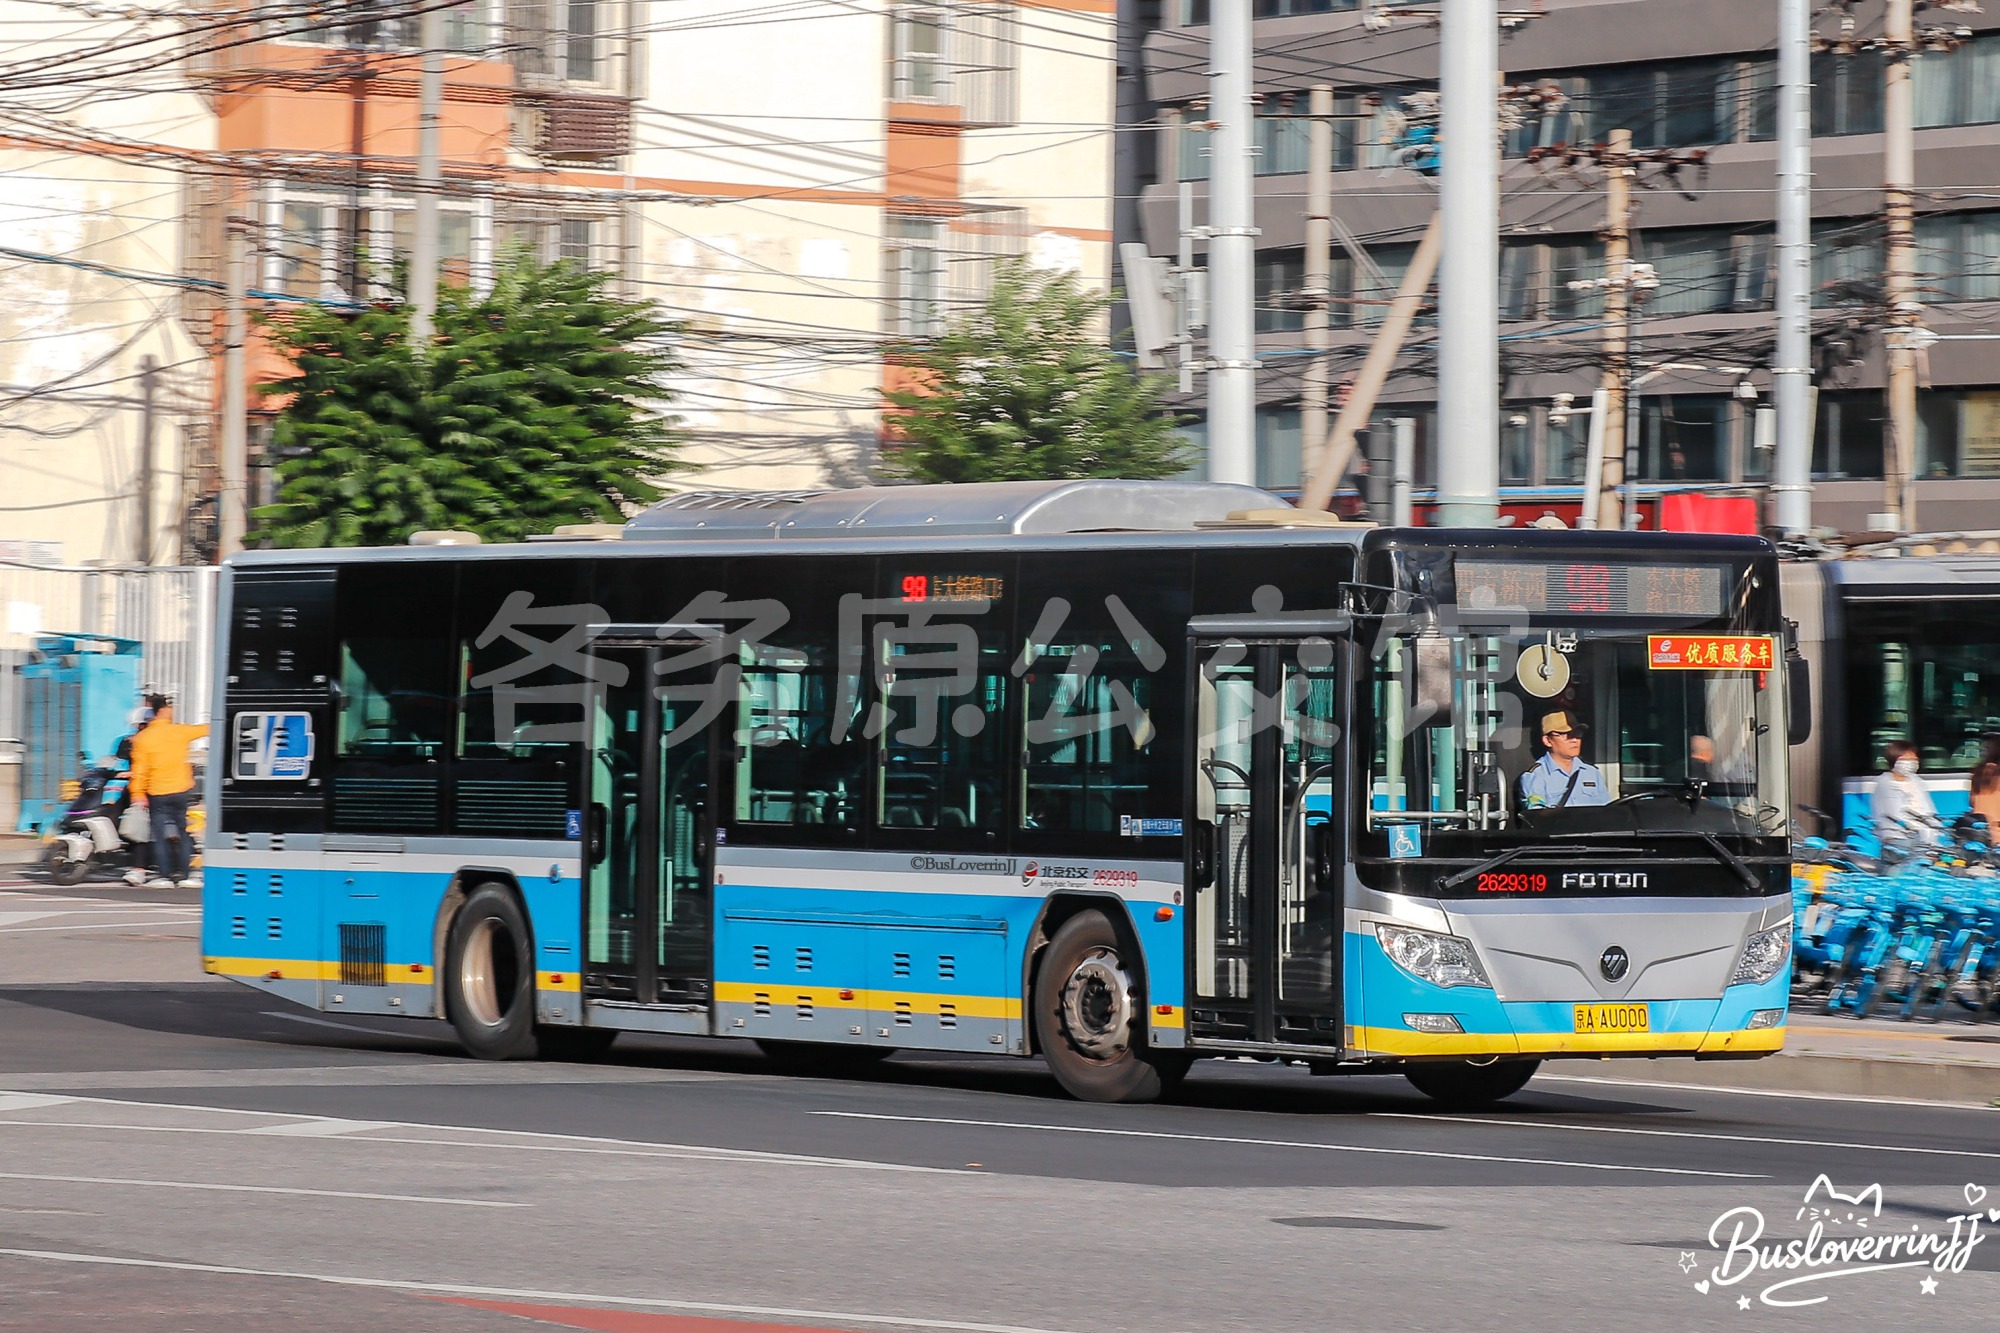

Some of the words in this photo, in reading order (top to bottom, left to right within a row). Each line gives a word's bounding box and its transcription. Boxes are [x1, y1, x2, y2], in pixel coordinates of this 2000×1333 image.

[901, 575, 928, 602] 98
[1565, 564, 1610, 612] 98
[1685, 641, 1770, 666] 优质服务车
[1041, 865, 1089, 879] 北京公交
[1092, 869, 1139, 888] 2629319
[1477, 873, 1547, 892] 2629319
